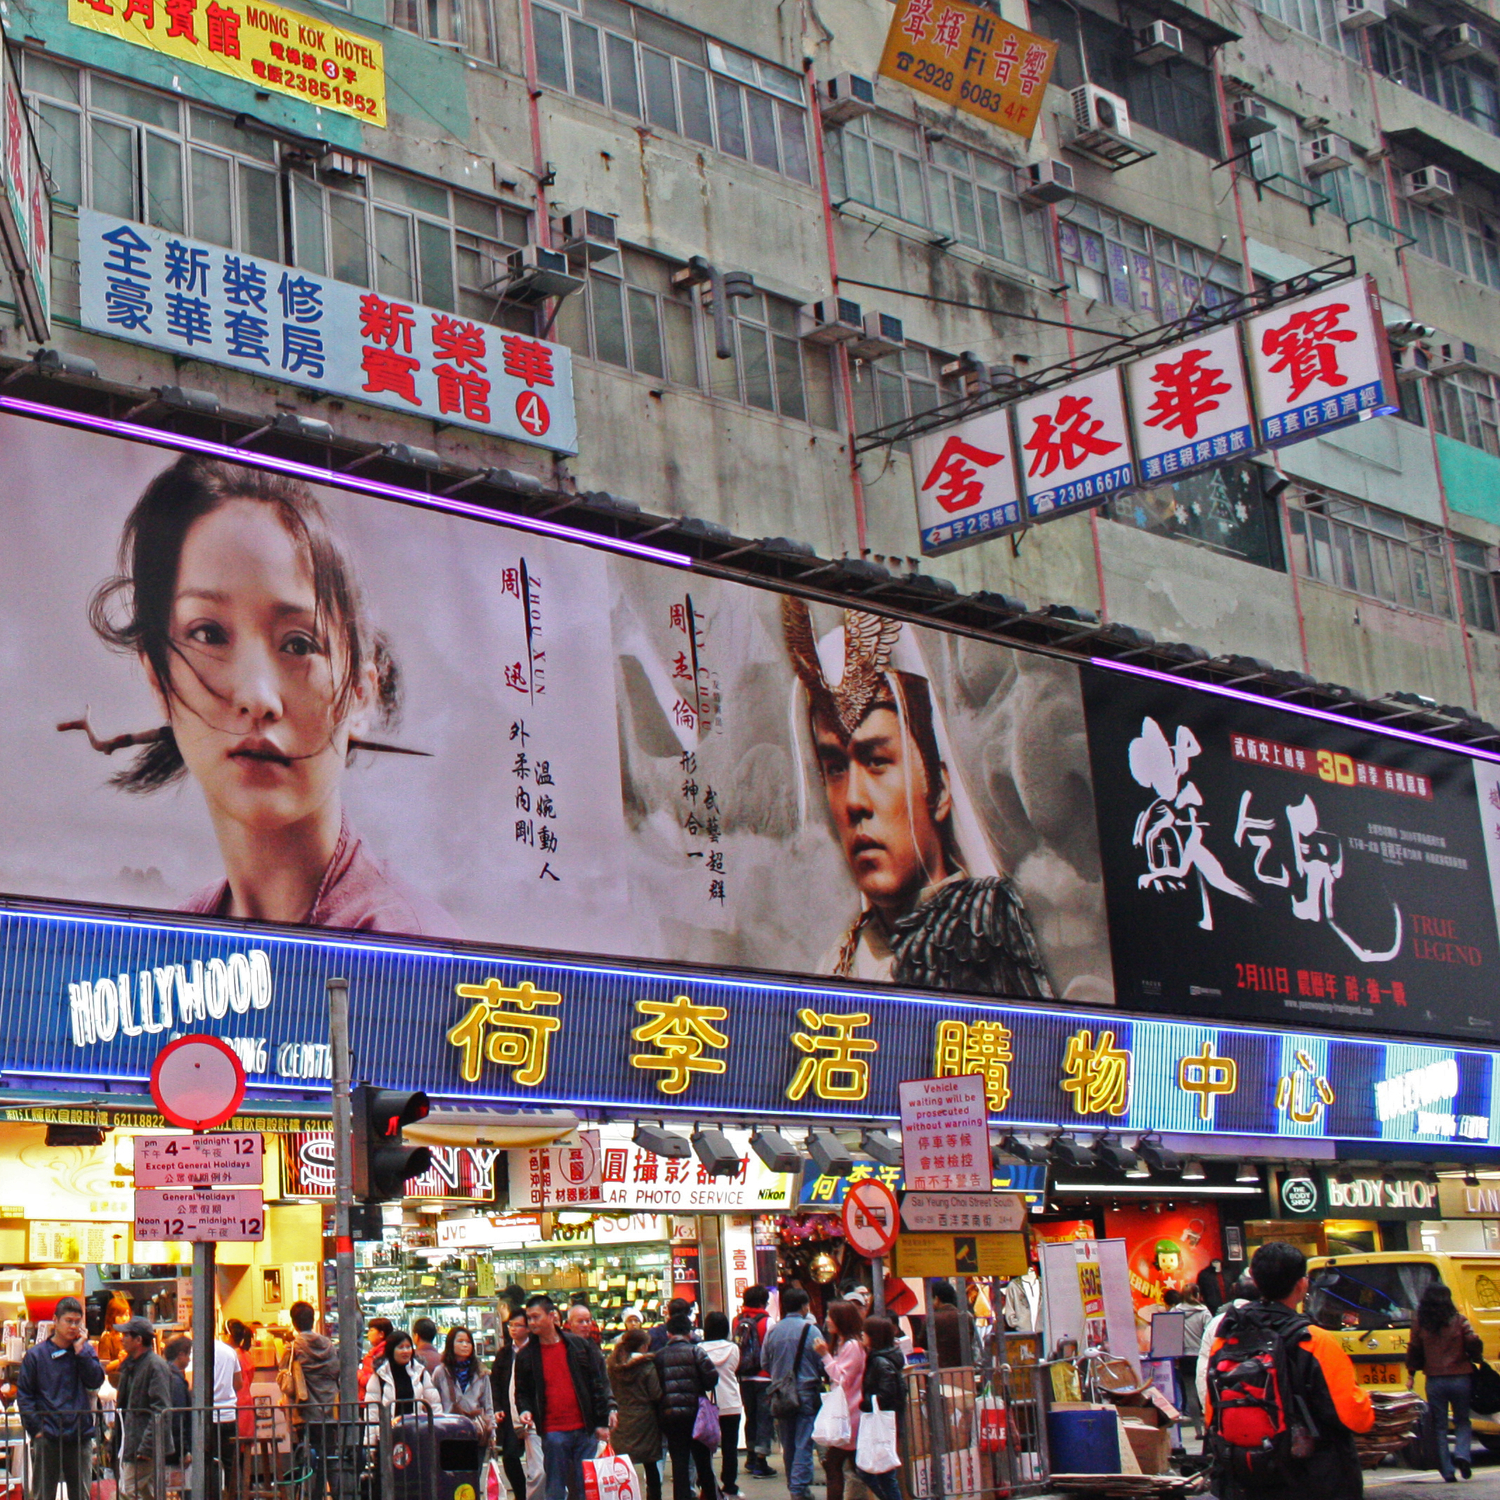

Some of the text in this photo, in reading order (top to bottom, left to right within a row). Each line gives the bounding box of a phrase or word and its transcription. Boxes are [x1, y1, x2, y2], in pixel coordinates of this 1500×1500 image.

[247, 5, 376, 70] MONG KOK HOTEL
[971, 14, 996, 46] Hi
[963, 46, 987, 76] Fi
[916, 58, 1029, 124] 2928 6083 4/F
[102, 224, 324, 324] 全新裝修
[104, 276, 326, 379] 豪華套房
[359, 293, 555, 388] 新榮華
[361, 344, 492, 425] 賓館
[1059, 467, 1131, 505] 2388 6670
[529, 577, 546, 695] ZHOU XUN
[670, 603, 698, 731] 周杰倫
[1317, 749, 1355, 787] 3D
[1410, 913, 1457, 939] TRUE
[1412, 938, 1481, 967] LEGEND
[1235, 964, 1289, 994] 2月11日
[69, 949, 272, 1047] HOLLYWOOD
[924, 1083, 958, 1093] Vehicle
[909, 1094, 976, 1107] waiting will be
[114, 1113, 166, 1129] 62118822
[916, 1106, 969, 1120] prosecuted
[905, 1118, 983, 1132] without warning
[165, 1141, 178, 1156] 4
[193, 1137, 230, 1146] midnight
[234, 1138, 254, 1154] 12
[919, 1133, 972, 1150] 停車等候
[141, 1148, 222, 1159] 下午 午夜
[921, 1153, 973, 1170] 會被檢控
[145, 1160, 251, 1171] Except General Holidays
[915, 1173, 980, 1190] 而不予警告
[162, 1193, 236, 1201] General Holidays
[636, 1189, 744, 1205] PHOTO SERVICE
[758, 1188, 785, 1200] Nikon
[911, 1197, 1015, 1208] Sai Yeung Choi Street South
[1327, 1178, 1437, 1208] BODY SHOP
[137, 1217, 260, 1235] Noon 12 midnight 12
[604, 1213, 657, 1233] SONY
[938, 1213, 992, 1227] 西洋菜南街
[139, 1228, 229, 1237] 中午 午夜
[1363, 1374, 1396, 1385] 3646
